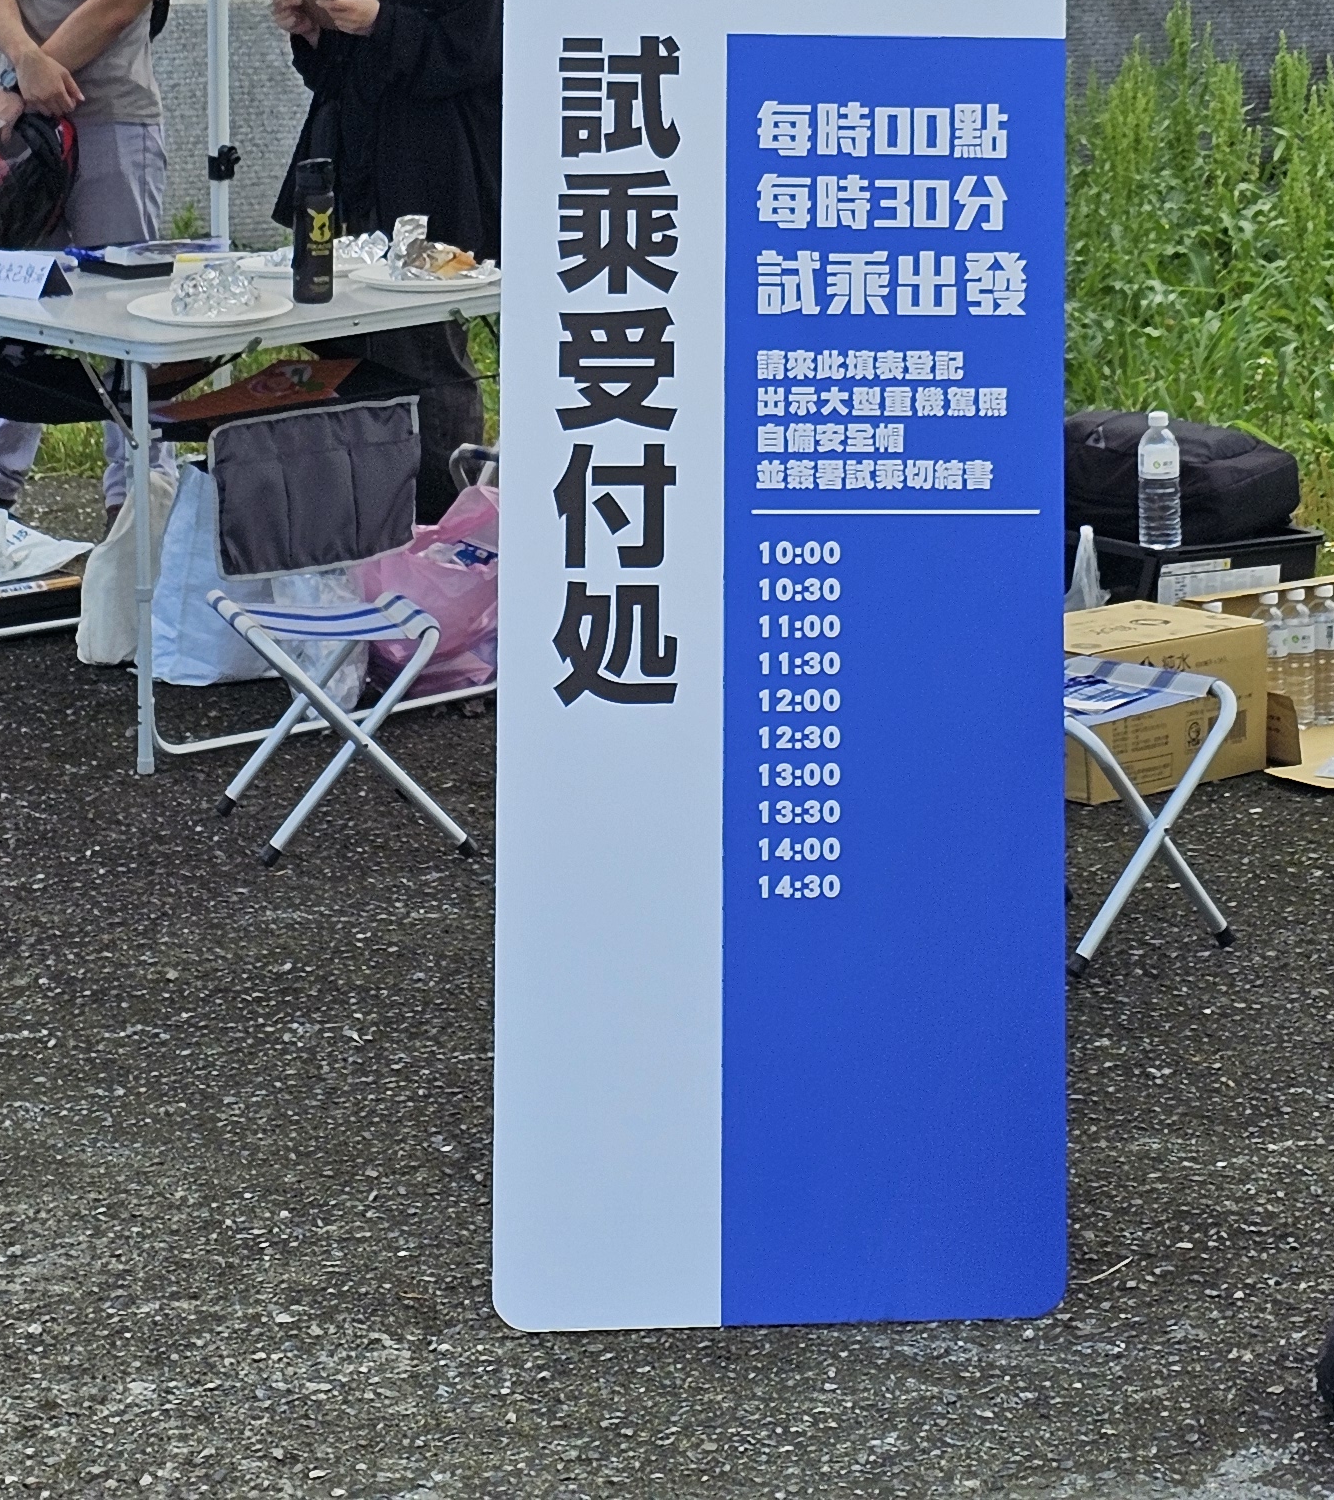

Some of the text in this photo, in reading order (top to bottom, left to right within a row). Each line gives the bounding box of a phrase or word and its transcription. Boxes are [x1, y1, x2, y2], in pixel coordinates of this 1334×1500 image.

[757, 101, 1009, 159] 每時00點
[757, 174, 1008, 231] 每時30分
[757, 250, 1028, 316] 試乘出發
[757, 350, 964, 380] 請來此填表登記
[758, 387, 1008, 416] 出示大型重機駕照
[758, 423, 905, 452] 自備安全帽
[757, 460, 994, 490] 並簽署試乘切結書
[760, 540, 841, 565] 10:00
[760, 577, 841, 602] 10:30
[760, 614, 841, 639] 11:00
[760, 651, 841, 676] 11:30
[760, 688, 841, 713] 12:00
[760, 726, 841, 751] 12:30
[760, 763, 841, 788] 13:00
[760, 800, 841, 825] 13:30
[760, 837, 841, 862] 14:00
[760, 874, 841, 899] 14:30
